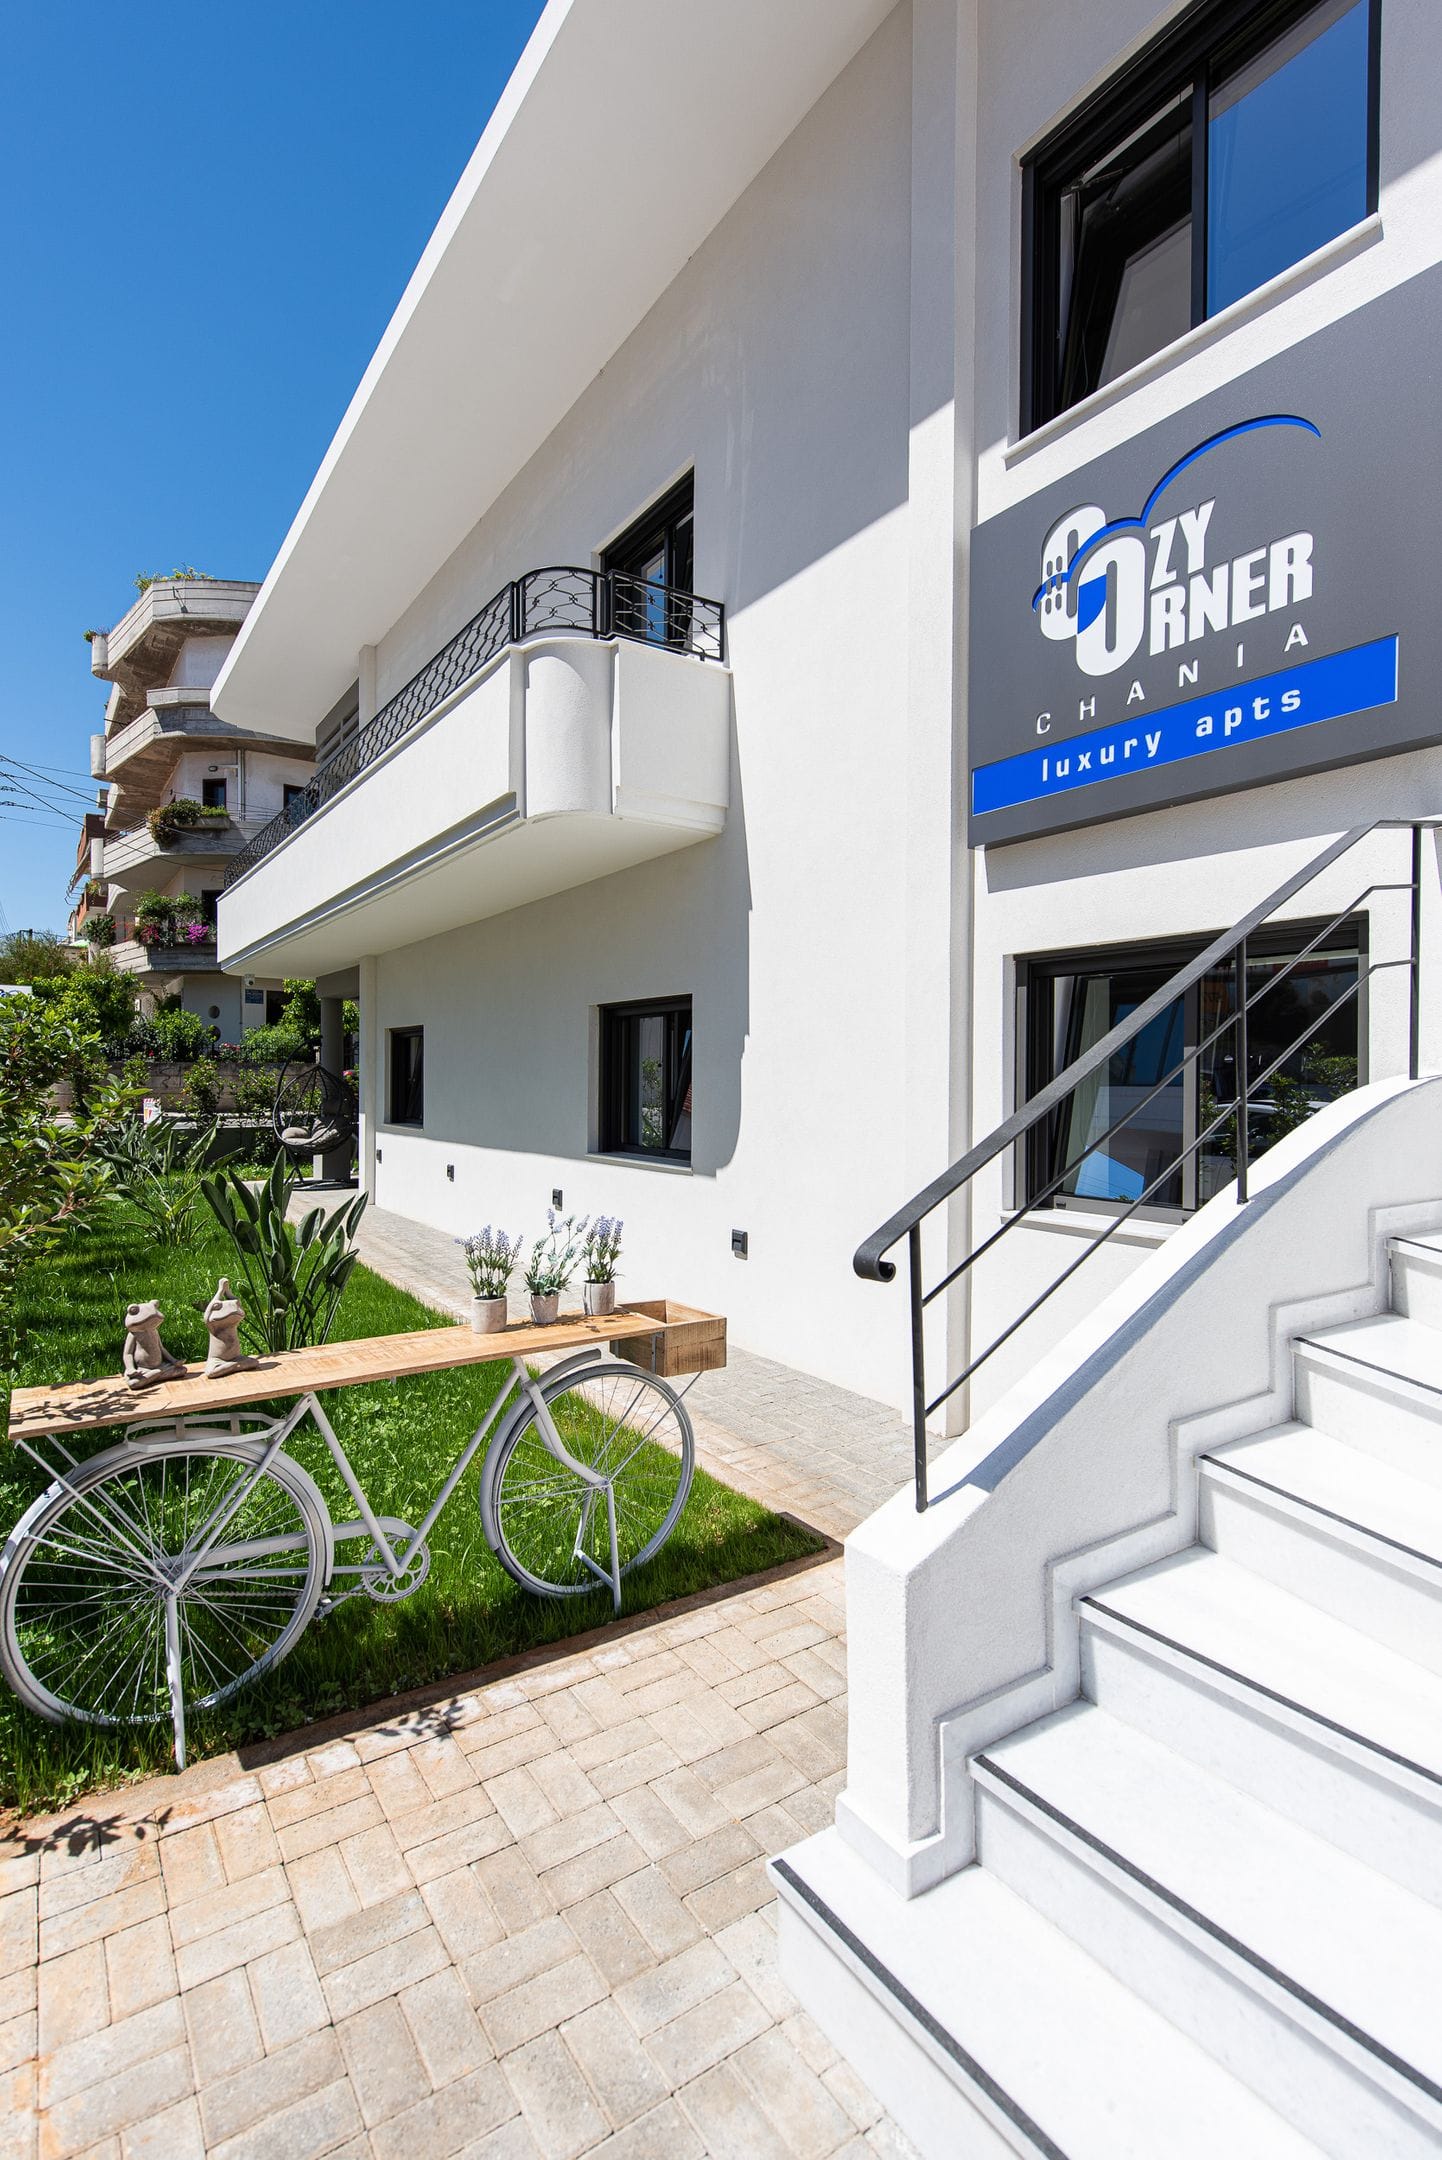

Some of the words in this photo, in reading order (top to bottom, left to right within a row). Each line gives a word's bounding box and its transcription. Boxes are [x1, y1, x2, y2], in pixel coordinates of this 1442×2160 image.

[1036, 623, 1309, 735] CHANIA
[1042, 731, 1162, 781] luxury
[1195, 689, 1301, 736] apts
